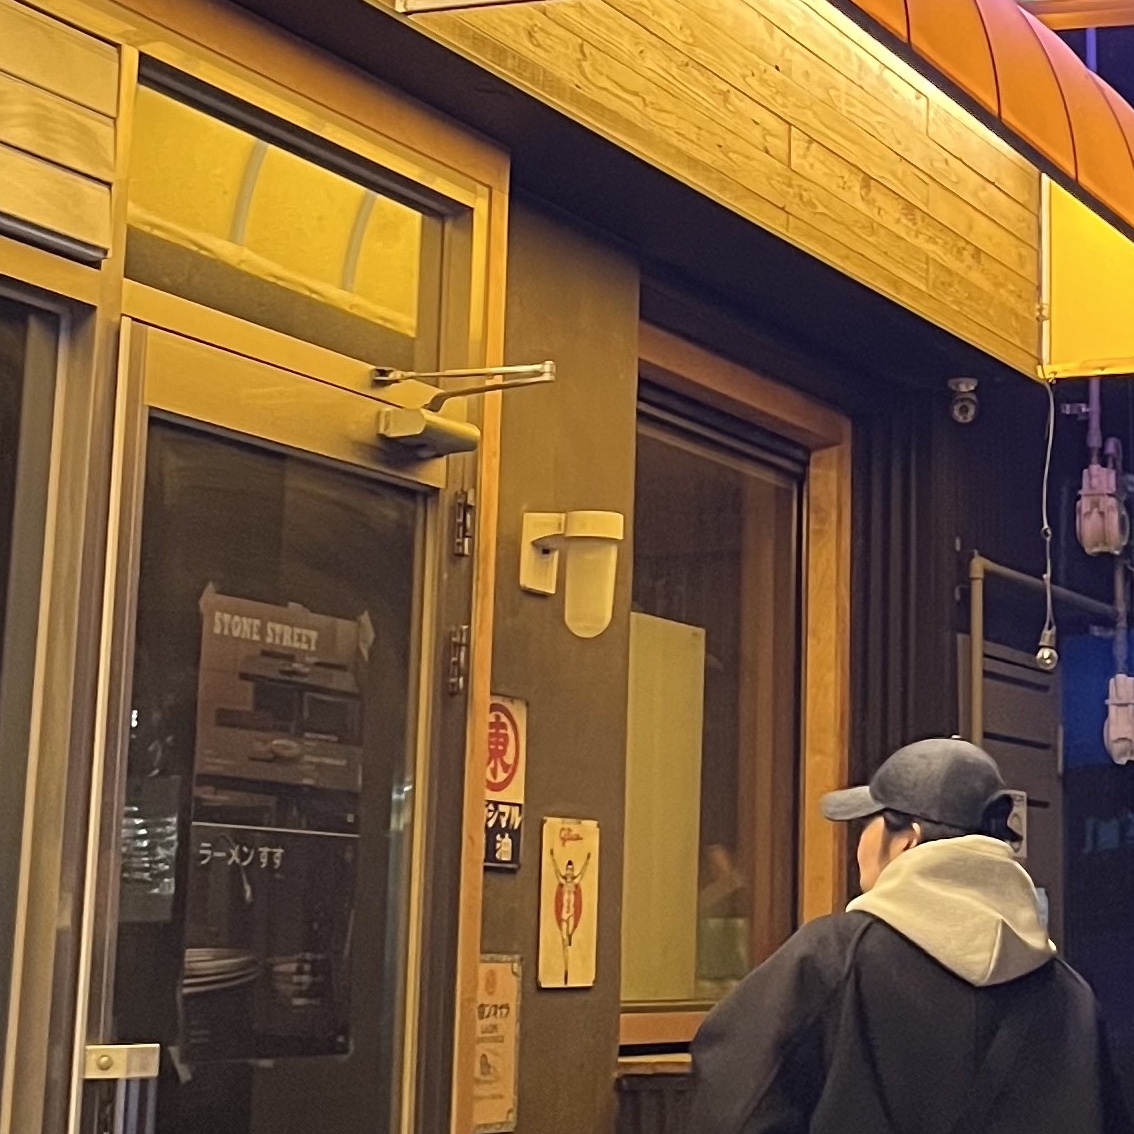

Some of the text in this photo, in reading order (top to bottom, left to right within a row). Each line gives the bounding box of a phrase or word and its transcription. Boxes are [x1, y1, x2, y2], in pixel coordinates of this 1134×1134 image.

[213, 611, 318, 651] STONE STREET
[485, 802, 522, 830] シマル
